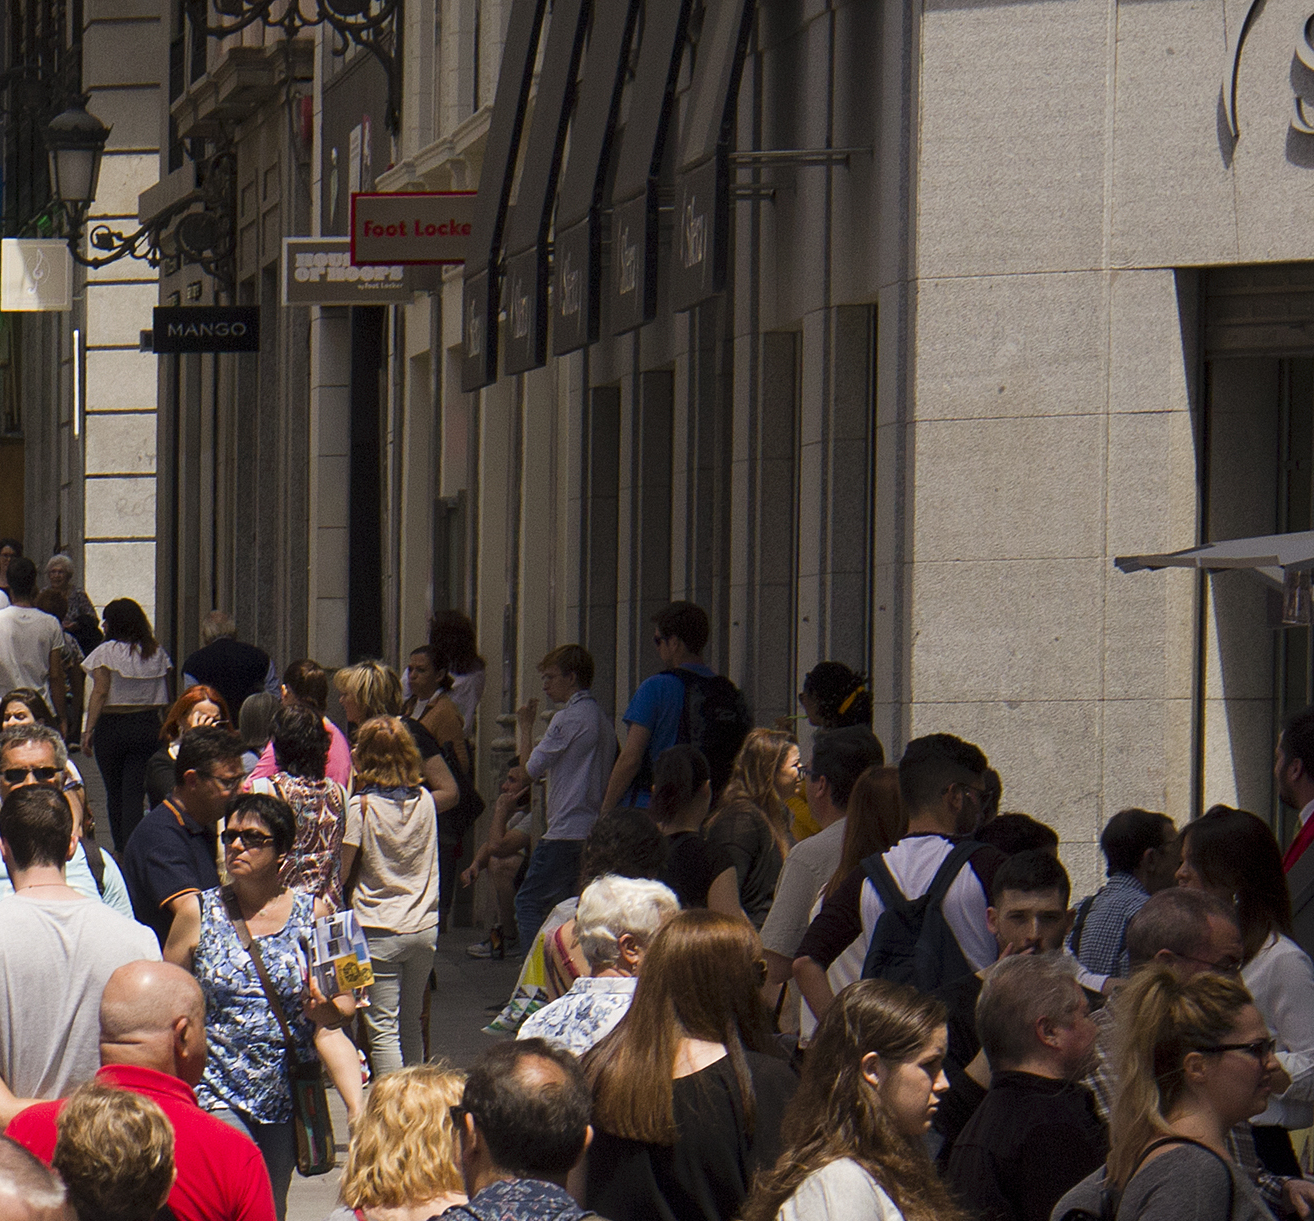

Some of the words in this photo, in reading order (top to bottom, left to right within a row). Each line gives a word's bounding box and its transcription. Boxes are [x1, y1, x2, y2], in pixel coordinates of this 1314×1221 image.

[364, 220, 407, 238] Foot
[294, 266, 325, 282] OF
[326, 264, 404, 282] HOOPS
[167, 321, 247, 336] MANGO
